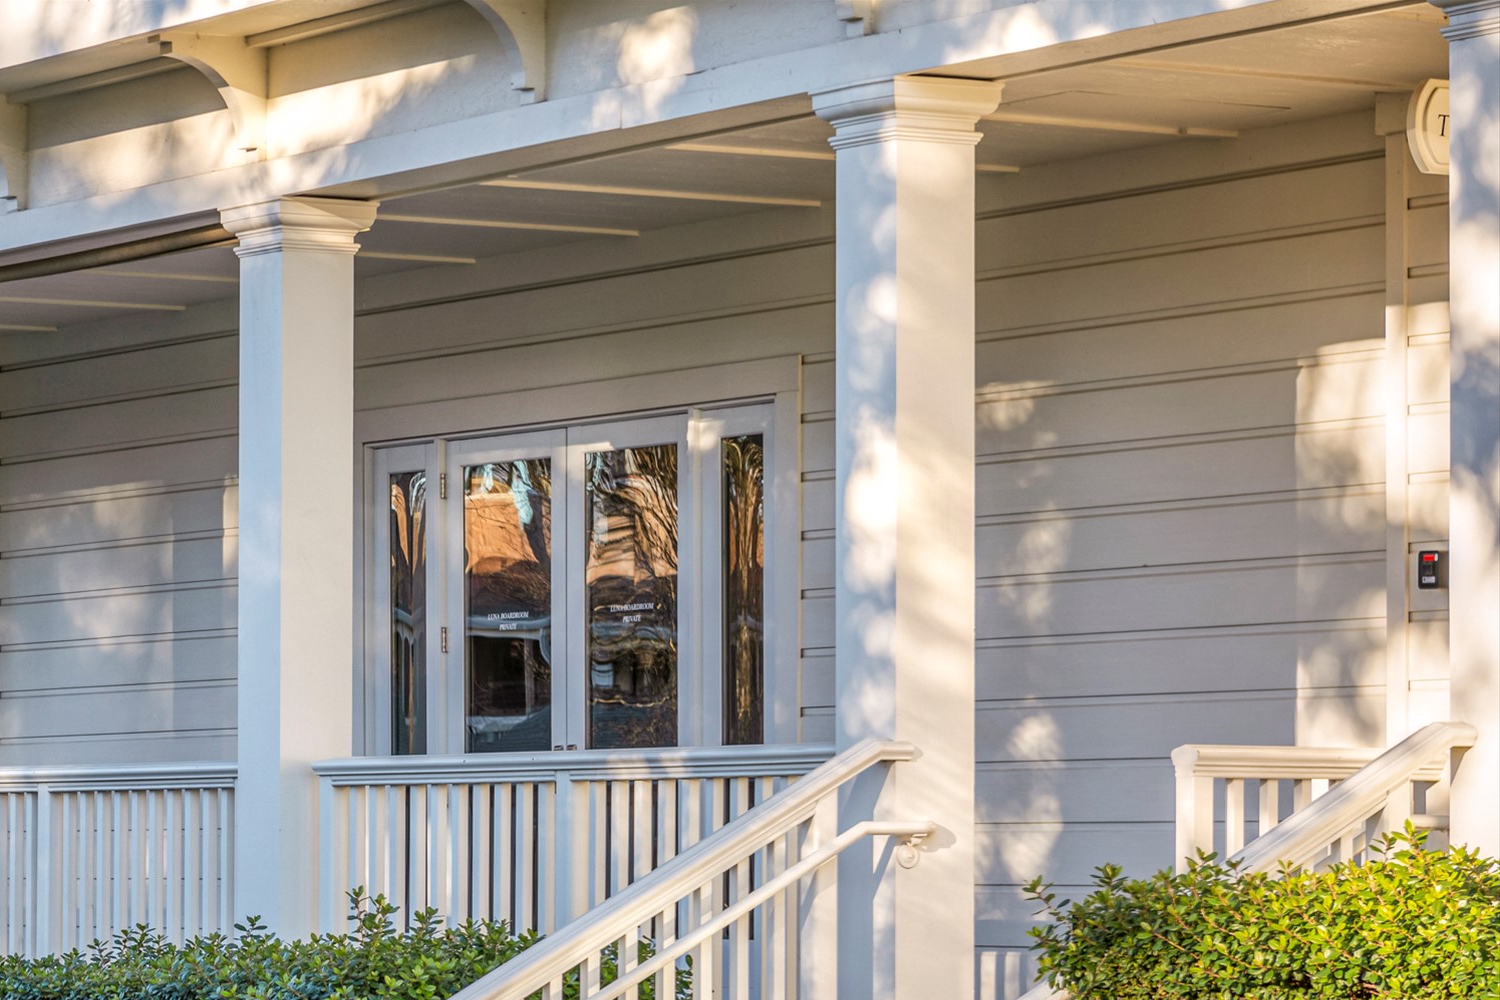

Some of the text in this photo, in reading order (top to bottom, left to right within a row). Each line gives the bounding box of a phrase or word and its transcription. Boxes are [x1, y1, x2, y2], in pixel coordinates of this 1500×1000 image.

[624, 602, 654, 611] BOARDROOM
[501, 611, 529, 620] BOARDROOM
[622, 614, 641, 623] PRIVATE
[499, 623, 517, 631] PRIVATE
